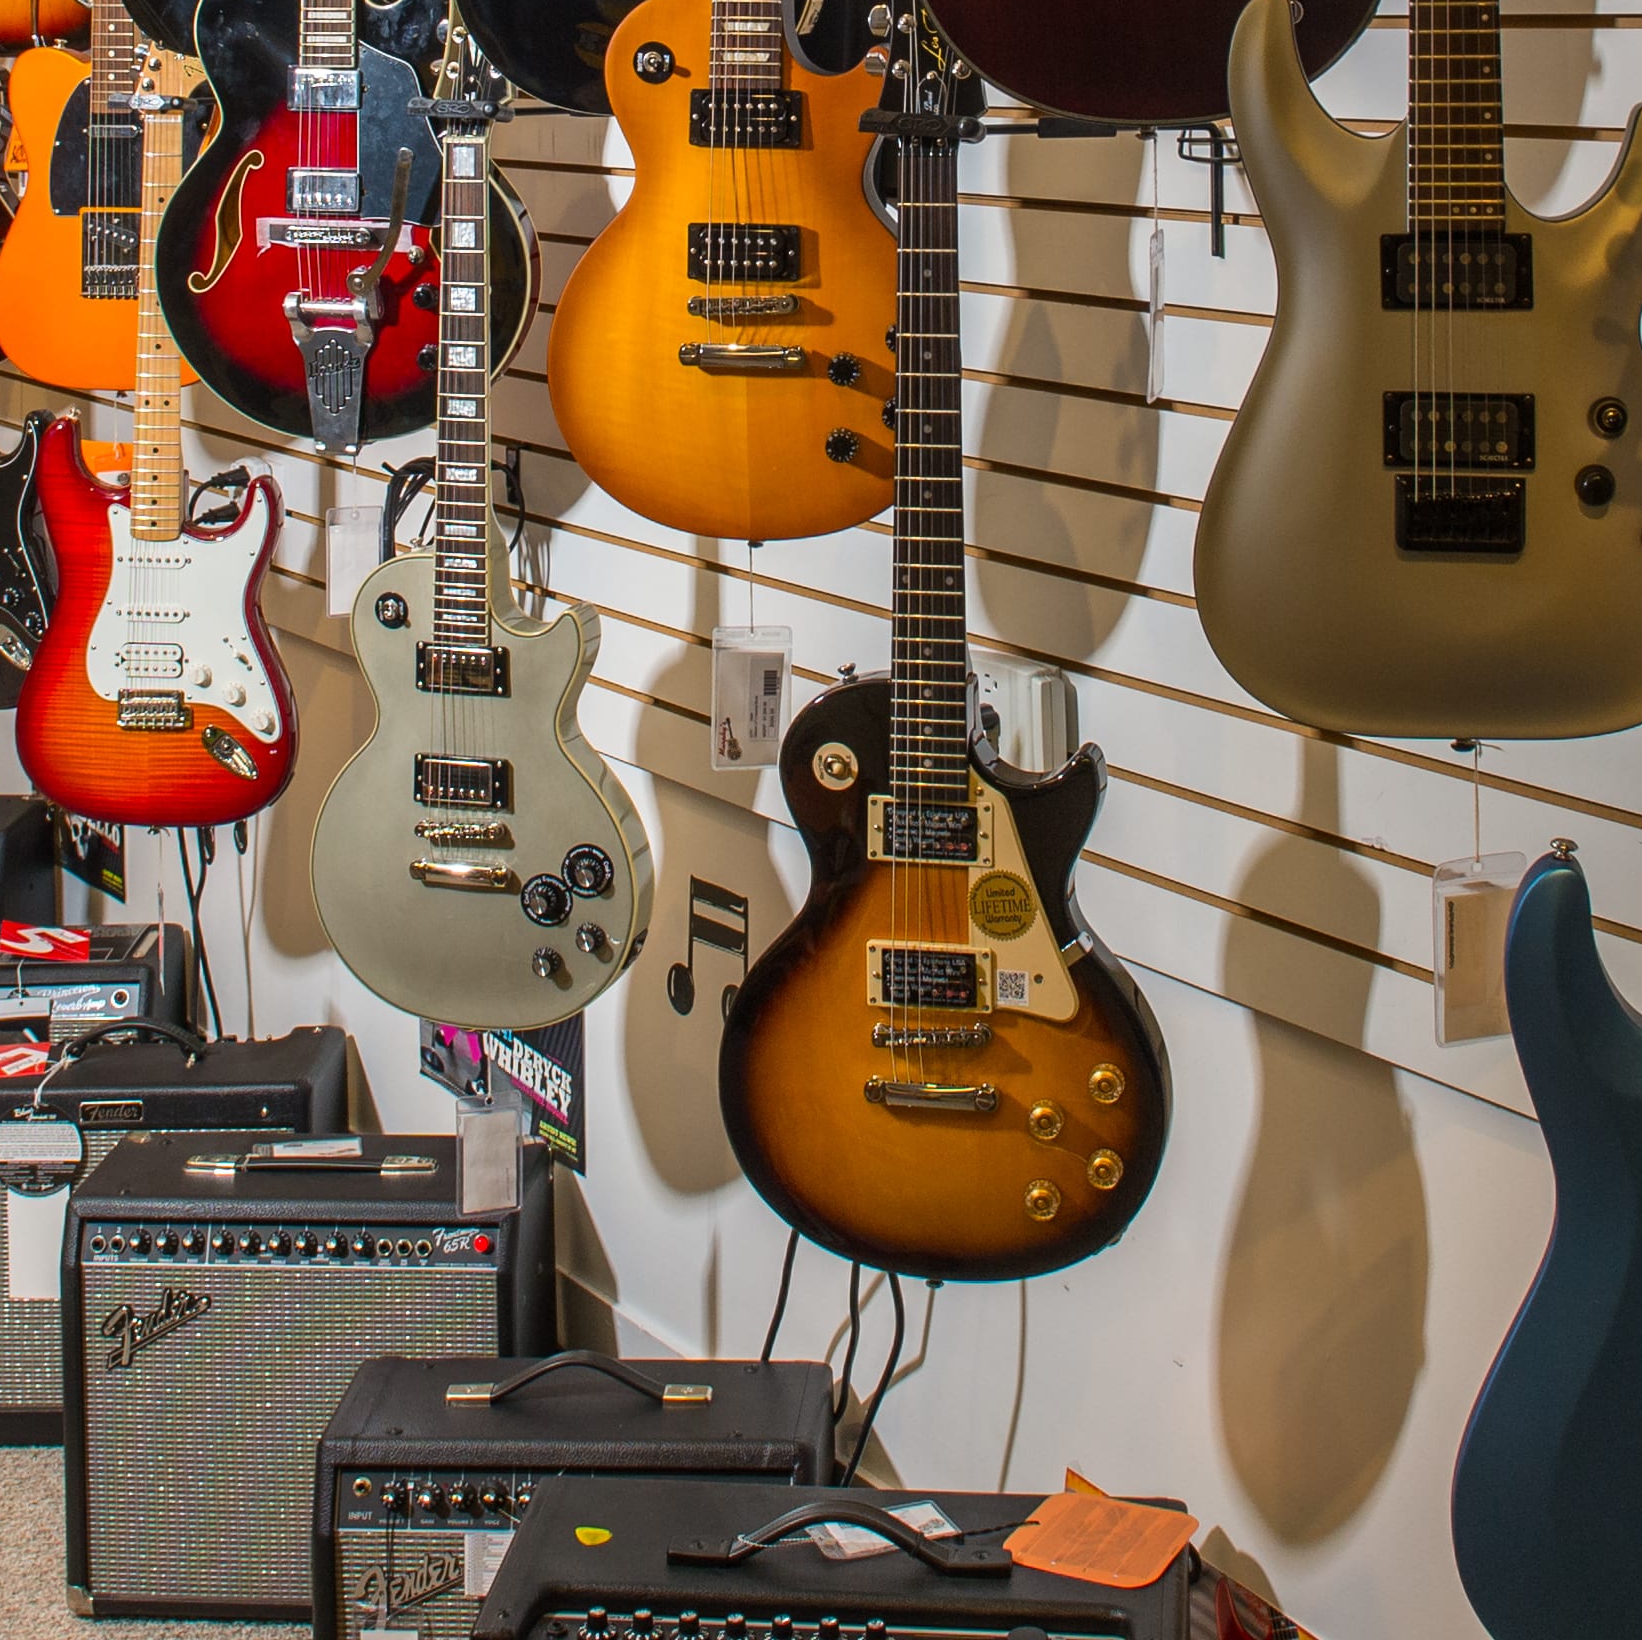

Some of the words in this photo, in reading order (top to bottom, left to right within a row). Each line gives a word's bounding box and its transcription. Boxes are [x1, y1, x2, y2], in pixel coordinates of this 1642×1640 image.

[955, 811, 969, 819] USA
[985, 887, 1016, 897] Limited
[973, 898, 1032, 915] LIFETIME
[984, 913, 1023, 925] Warranty
[513, 1034, 573, 1095] DERYCK
[482, 1031, 572, 1117] WHIBLEY
[84, 1103, 139, 1121] Fender
[443, 1237, 472, 1254] 65R
[92, 1254, 119, 1263] INPUTS
[101, 1287, 212, 1371] Fender
[348, 1511, 373, 1522] INPUT
[356, 1552, 464, 1631] Fender
